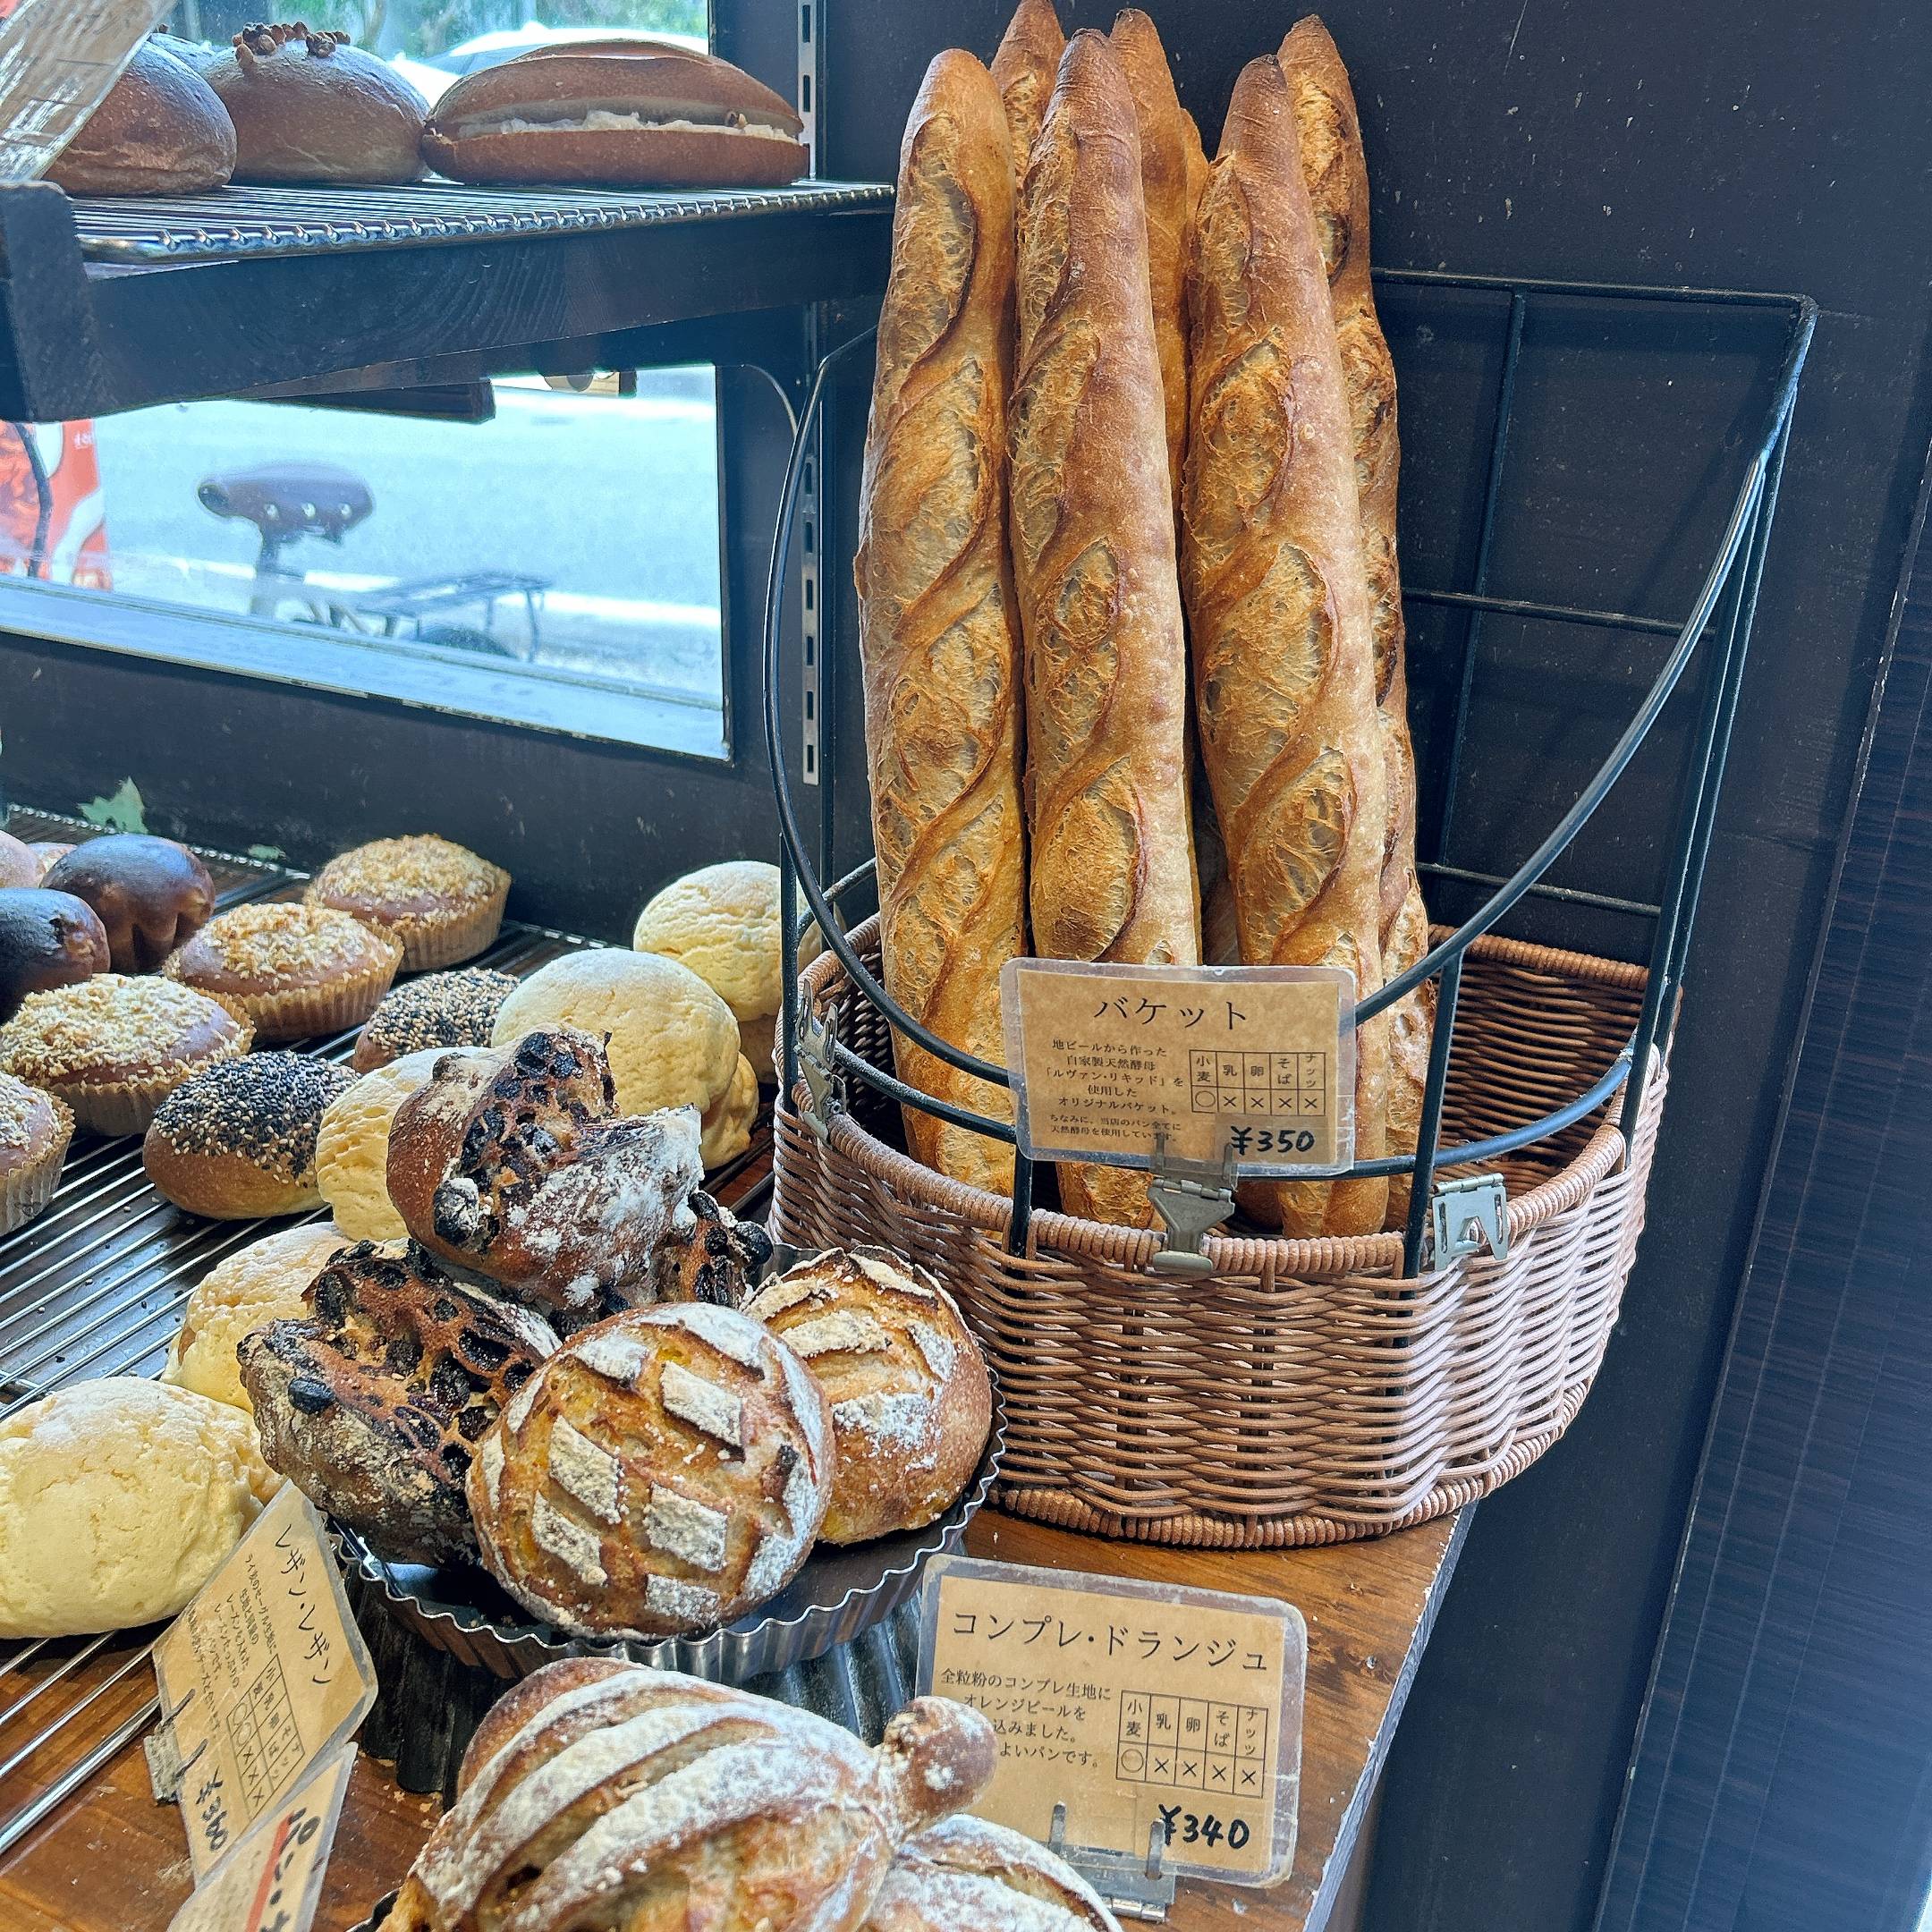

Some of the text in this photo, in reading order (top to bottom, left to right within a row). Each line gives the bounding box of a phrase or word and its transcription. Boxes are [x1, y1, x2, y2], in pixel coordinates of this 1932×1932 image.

[1093, 996, 1247, 1030] バケット
[1051, 1038, 1167, 1057] 地ビールから作った
[1067, 1055, 1156, 1072] 自家製天然酵母
[1196, 1055, 1211, 1082] 小麦
[1223, 1064, 1237, 1077] 乳
[1250, 1065, 1264, 1076] 卵
[1277, 1058, 1292, 1085] そば
[1305, 1055, 1317, 1088] ナッツ
[1088, 1084, 1138, 1097] 使用した
[1230, 1125, 1315, 1156] ¥350
[275, 1523, 332, 1684] レザン・レザン
[952, 1609, 1268, 1672] コンプレ・ドランジュ
[940, 1667, 1112, 1700] 全粒粉のコンプレ生地に
[1125, 1699, 1142, 1738] 小麦
[1156, 1712, 1171, 1730] 乳
[1186, 1716, 1200, 1733] 卵
[1214, 1710, 1231, 1748] そば
[1245, 1708, 1258, 1756] ナッツ
[1158, 1803, 1250, 1850] ¥340
